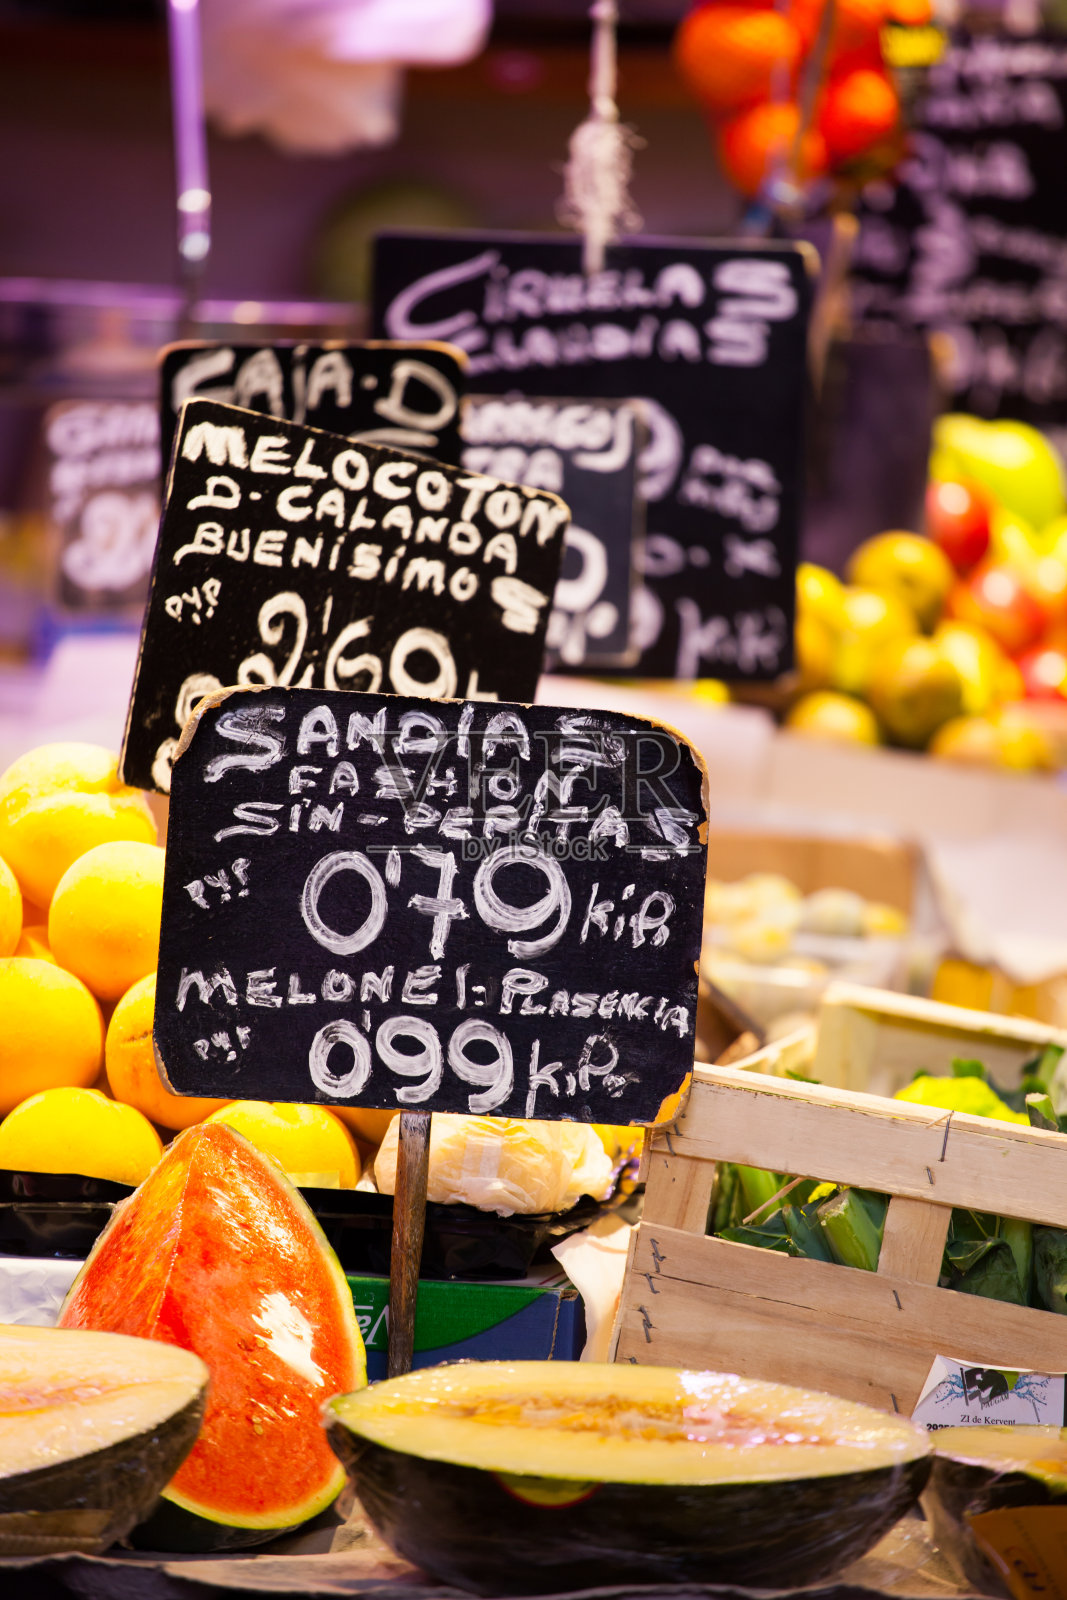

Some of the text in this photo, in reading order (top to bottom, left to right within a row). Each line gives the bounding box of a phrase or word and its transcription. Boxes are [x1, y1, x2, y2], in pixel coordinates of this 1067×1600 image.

[182, 421, 568, 547] MELOCOTON
[277, 485, 518, 574] CALANDA
[204, 704, 630, 783] SANDIAS
[288, 761, 586, 804] FASHION
[972, 1415, 982, 1424] de
